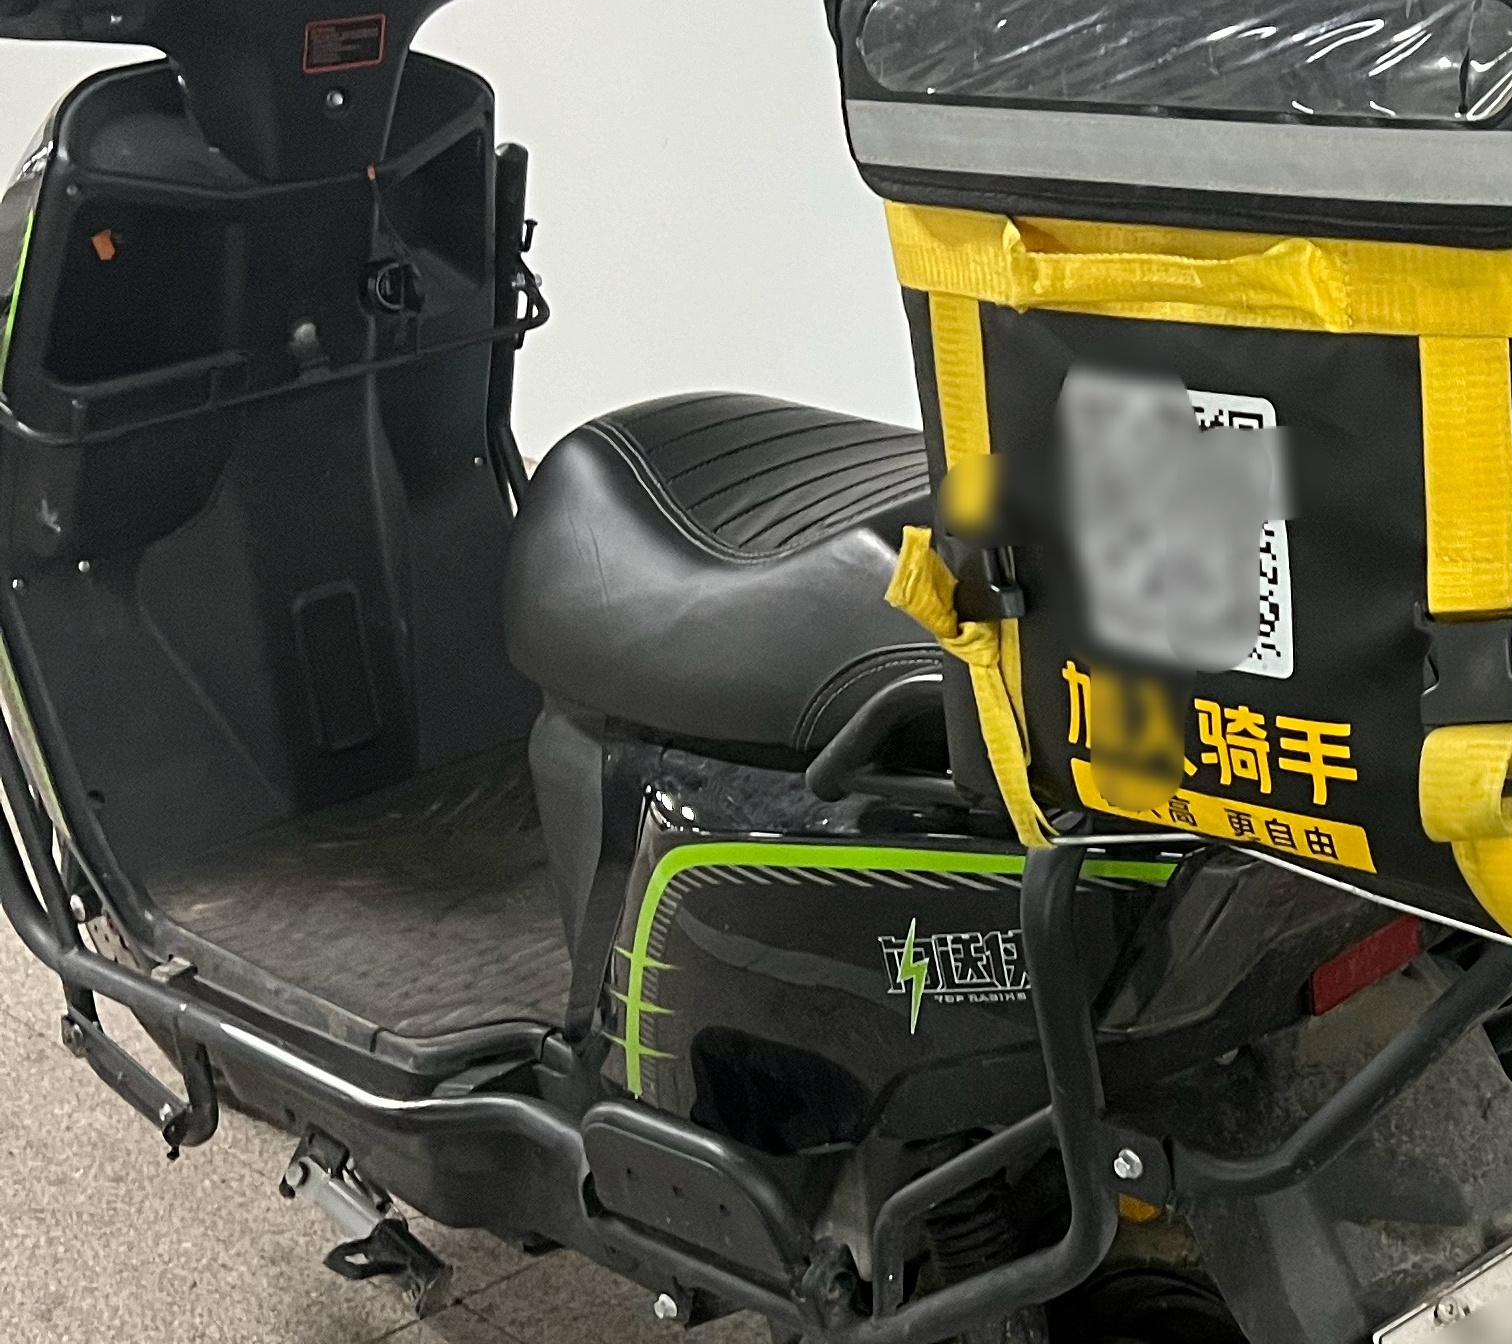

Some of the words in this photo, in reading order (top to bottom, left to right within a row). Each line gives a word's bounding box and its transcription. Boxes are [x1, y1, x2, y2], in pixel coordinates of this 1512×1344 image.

[1062, 661, 1358, 805] 骑手
[1224, 808, 1339, 851] 更自由
